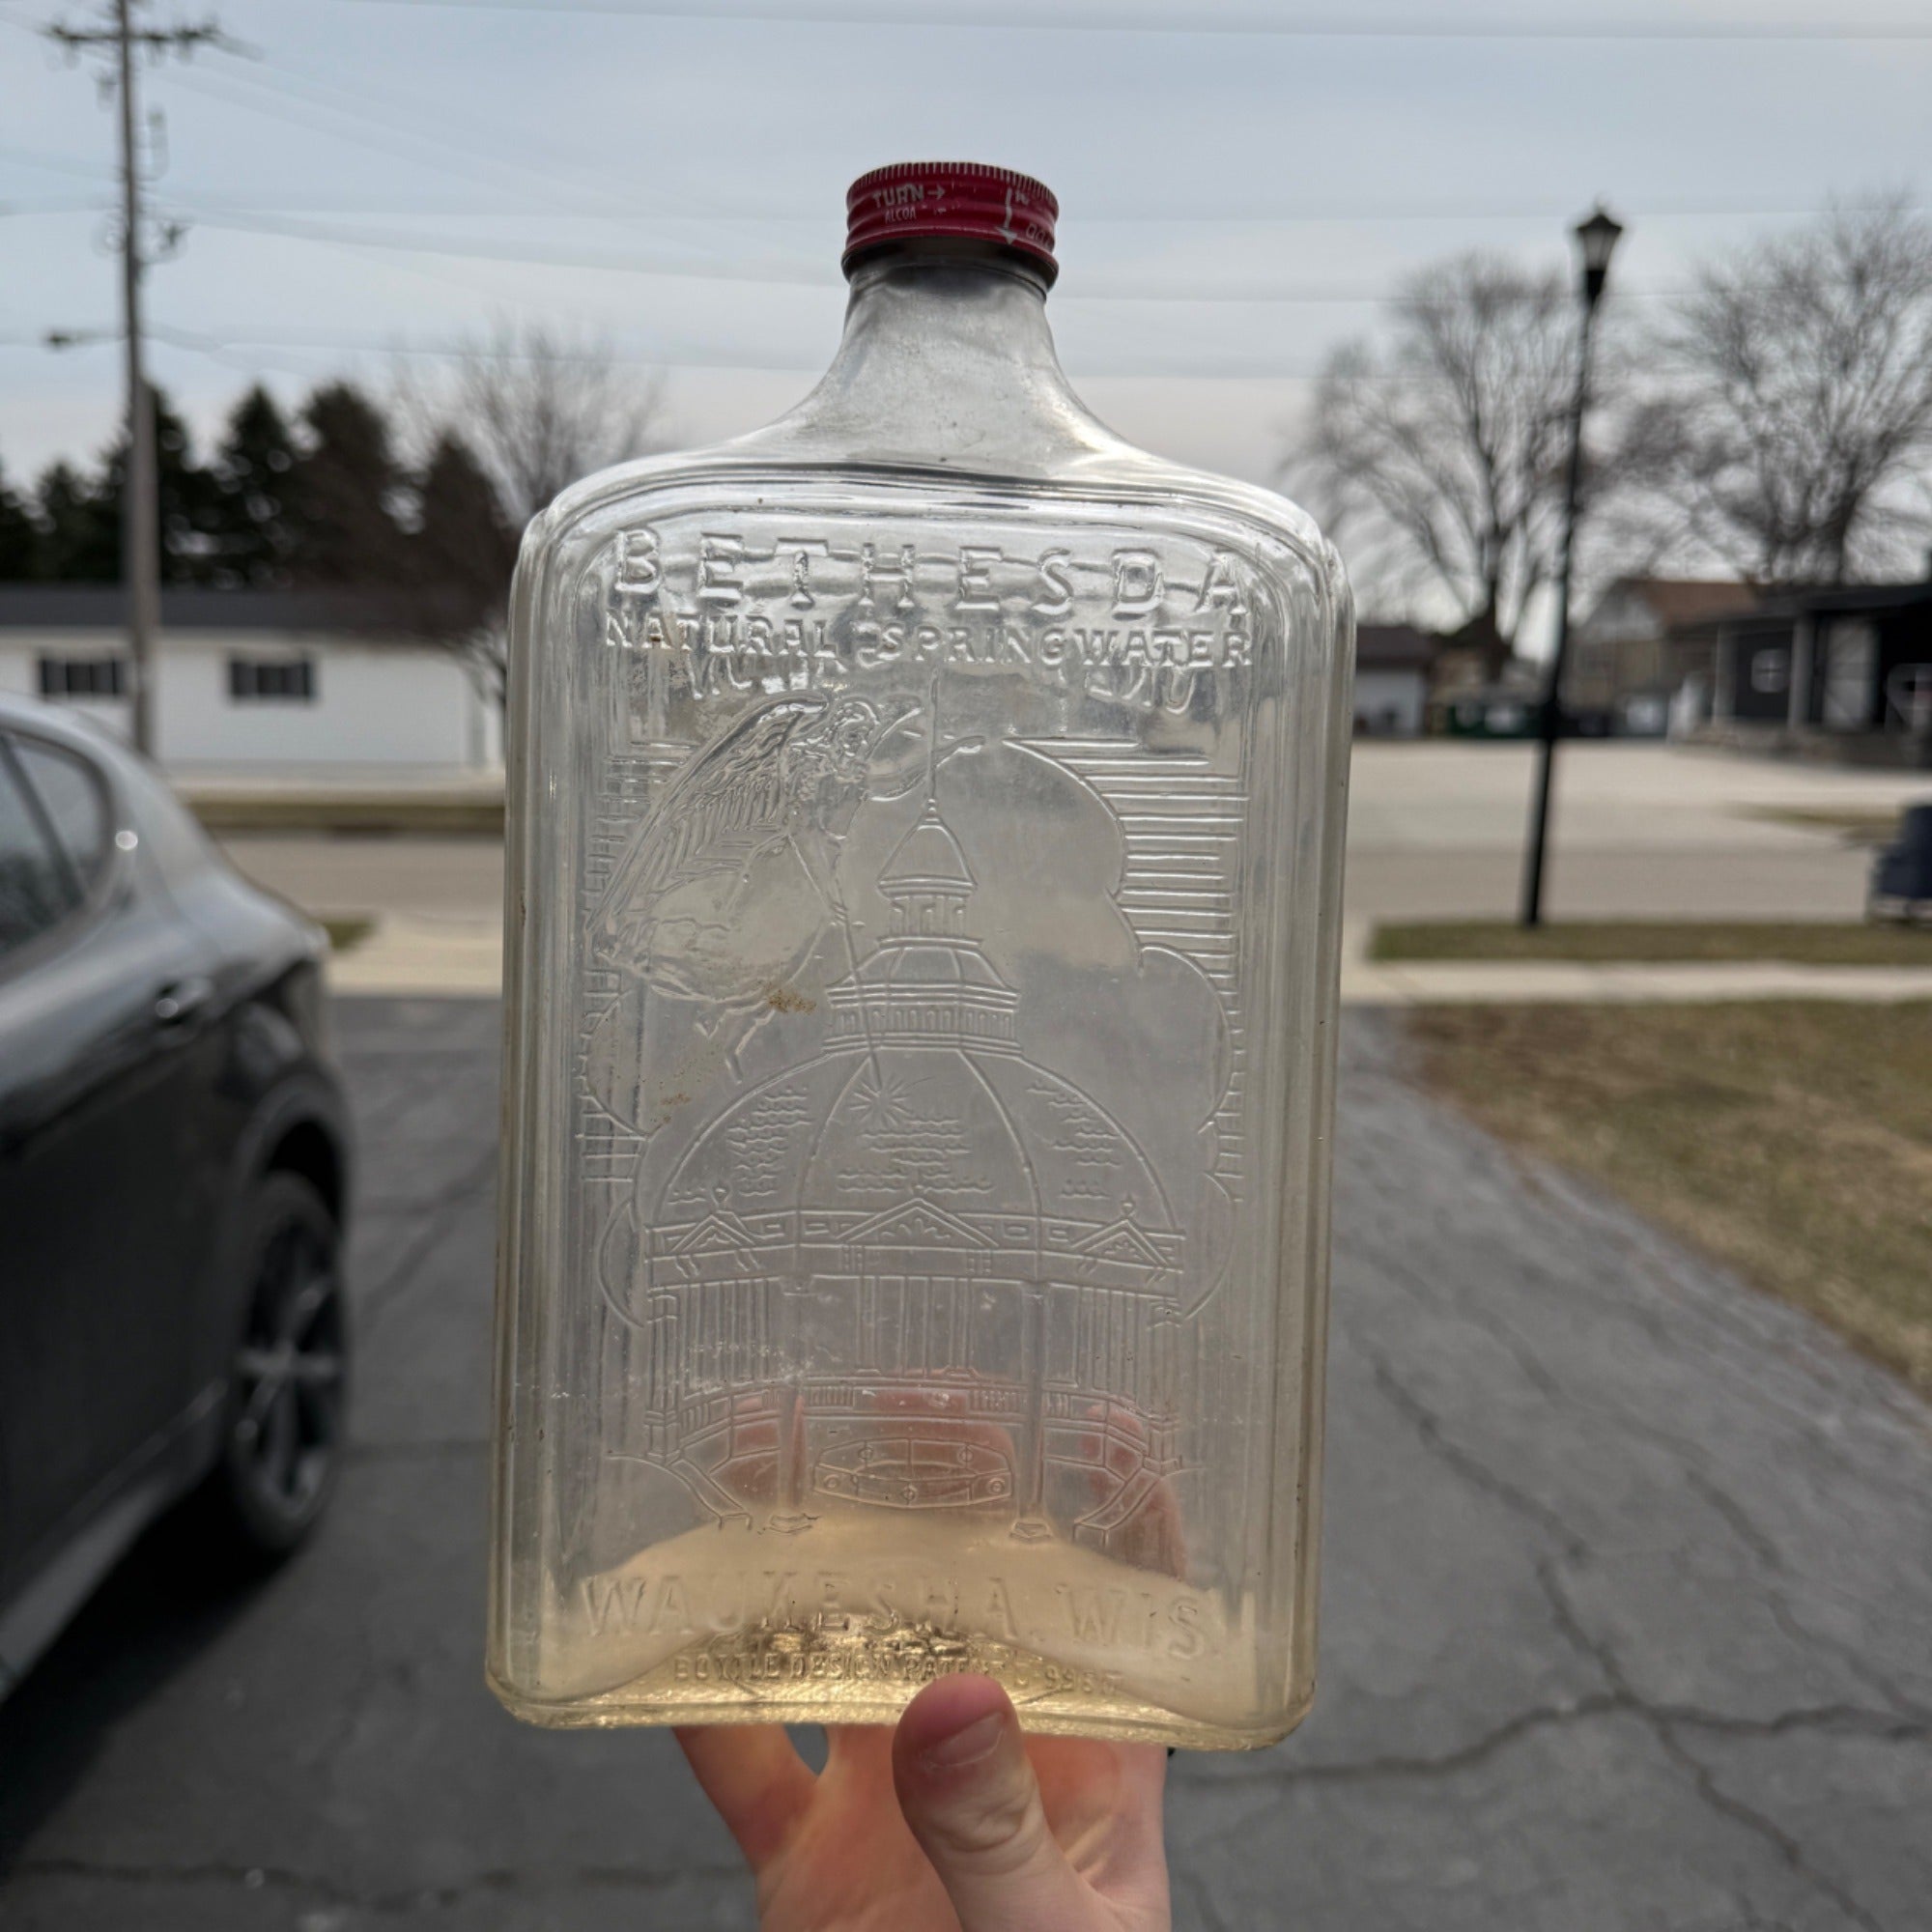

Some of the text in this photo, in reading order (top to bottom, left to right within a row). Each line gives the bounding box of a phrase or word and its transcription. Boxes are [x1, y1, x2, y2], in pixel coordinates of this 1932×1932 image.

[871, 183, 924, 209] TURN
[885, 207, 917, 223] ALCOA
[613, 528, 1249, 615] BETHESDA
[606, 610, 1252, 668] NATURAL SPRING WATER
